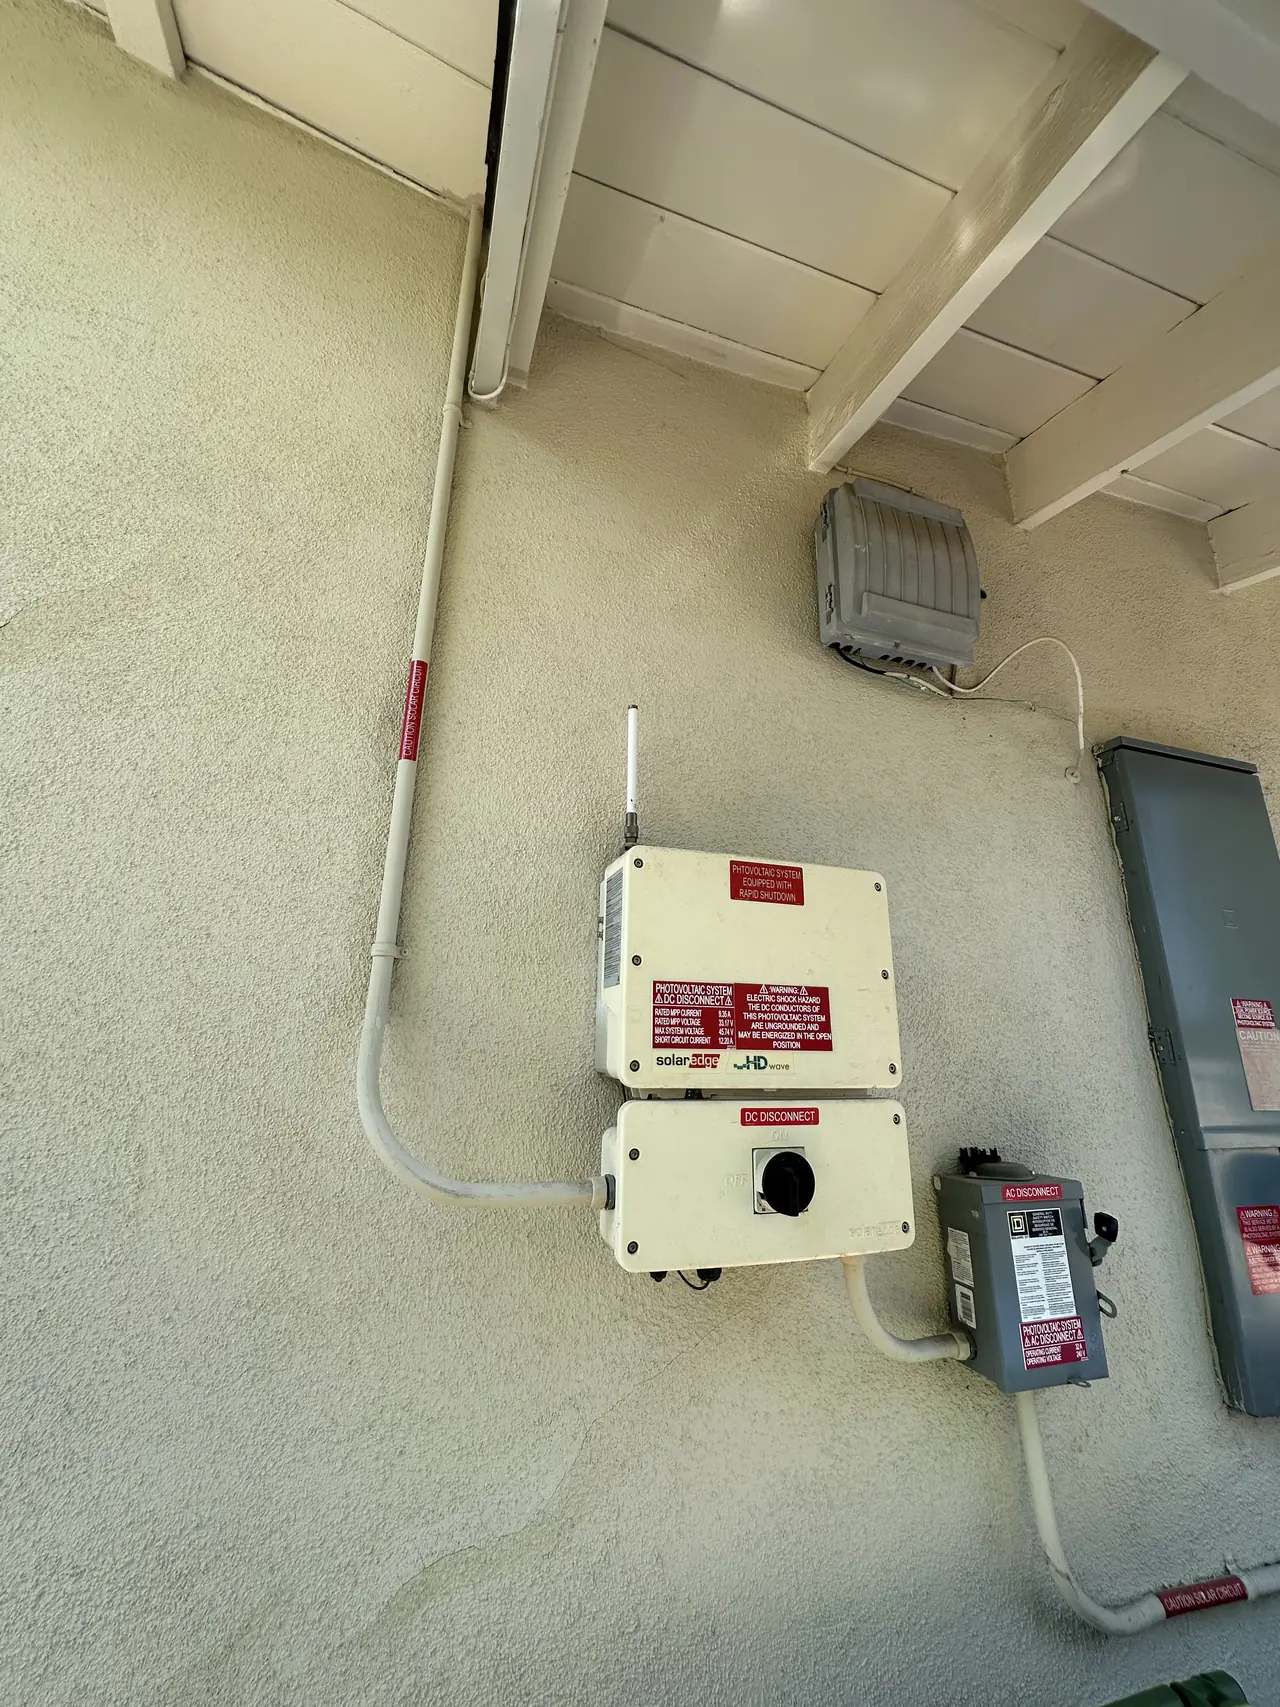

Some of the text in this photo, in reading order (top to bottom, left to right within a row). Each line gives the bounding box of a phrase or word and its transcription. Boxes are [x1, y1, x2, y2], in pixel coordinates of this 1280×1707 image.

[403, 665, 423, 756] CAUTION SOLAR CIRCUIT
[776, 869, 801, 879] SYSTEM
[743, 877, 792, 890] EQUIPPED WITH
[739, 888, 796, 902] RAPID SHUTDOWN
[655, 983, 732, 996] PHOTOVOLTAIC SYSTEM
[664, 994, 724, 1005] DC DISCONNECT
[746, 994, 821, 1004] ELECTRIC SHOCK HAZARD
[654, 1008, 670, 1016] RATED
[670, 1008, 680, 1016] MPP
[681, 1009, 702, 1017] CURRENT
[748, 1003, 820, 1013] THE DC CONDUCTORS OF
[654, 1017, 670, 1025] RATED
[681, 1018, 701, 1026] VOLTAGE
[743, 1012, 826, 1022] THIS PHOTOVOLTAIC SYSTEM
[654, 1026, 665, 1034] MAX
[665, 1027, 684, 1035] SYSTEM
[684, 1027, 704, 1035] VOLTAGE
[751, 1022, 819, 1031] ARE UNGROUNDED AND
[654, 1035, 670, 1044] SHORT
[670, 1036, 689, 1044] CIRCUIT
[689, 1036, 711, 1044] CURRENT
[738, 1031, 833, 1040] MAY BE ENERGIZED IN THE OPEN
[1239, 1031, 1280, 1041] CAUTION
[772, 1041, 801, 1049] POSITION
[656, 1053, 720, 1068] solaredge
[768, 1063, 790, 1071] wave
[745, 1111, 815, 1122] DC DISCONNECT
[770, 1129, 789, 1141] ON
[724, 1174, 748, 1187] OFF
[1006, 1186, 1059, 1198] AC DISCONNECT
[1244, 1209, 1272, 1218] WARNING
[1022, 1318, 1082, 1336] PHOTOVOLTAIC SYSTEM
[1031, 1329, 1076, 1346] AC DISCONNECT
[1025, 1348, 1045, 1358] OPERATING
[1045, 1345, 1061, 1355] CURRENT
[1026, 1356, 1047, 1366] OPERATING
[1046, 1353, 1062, 1363] VOLTAGE
[1163, 1582, 1244, 1611] CAUTION SOLAR CIRCUIT
